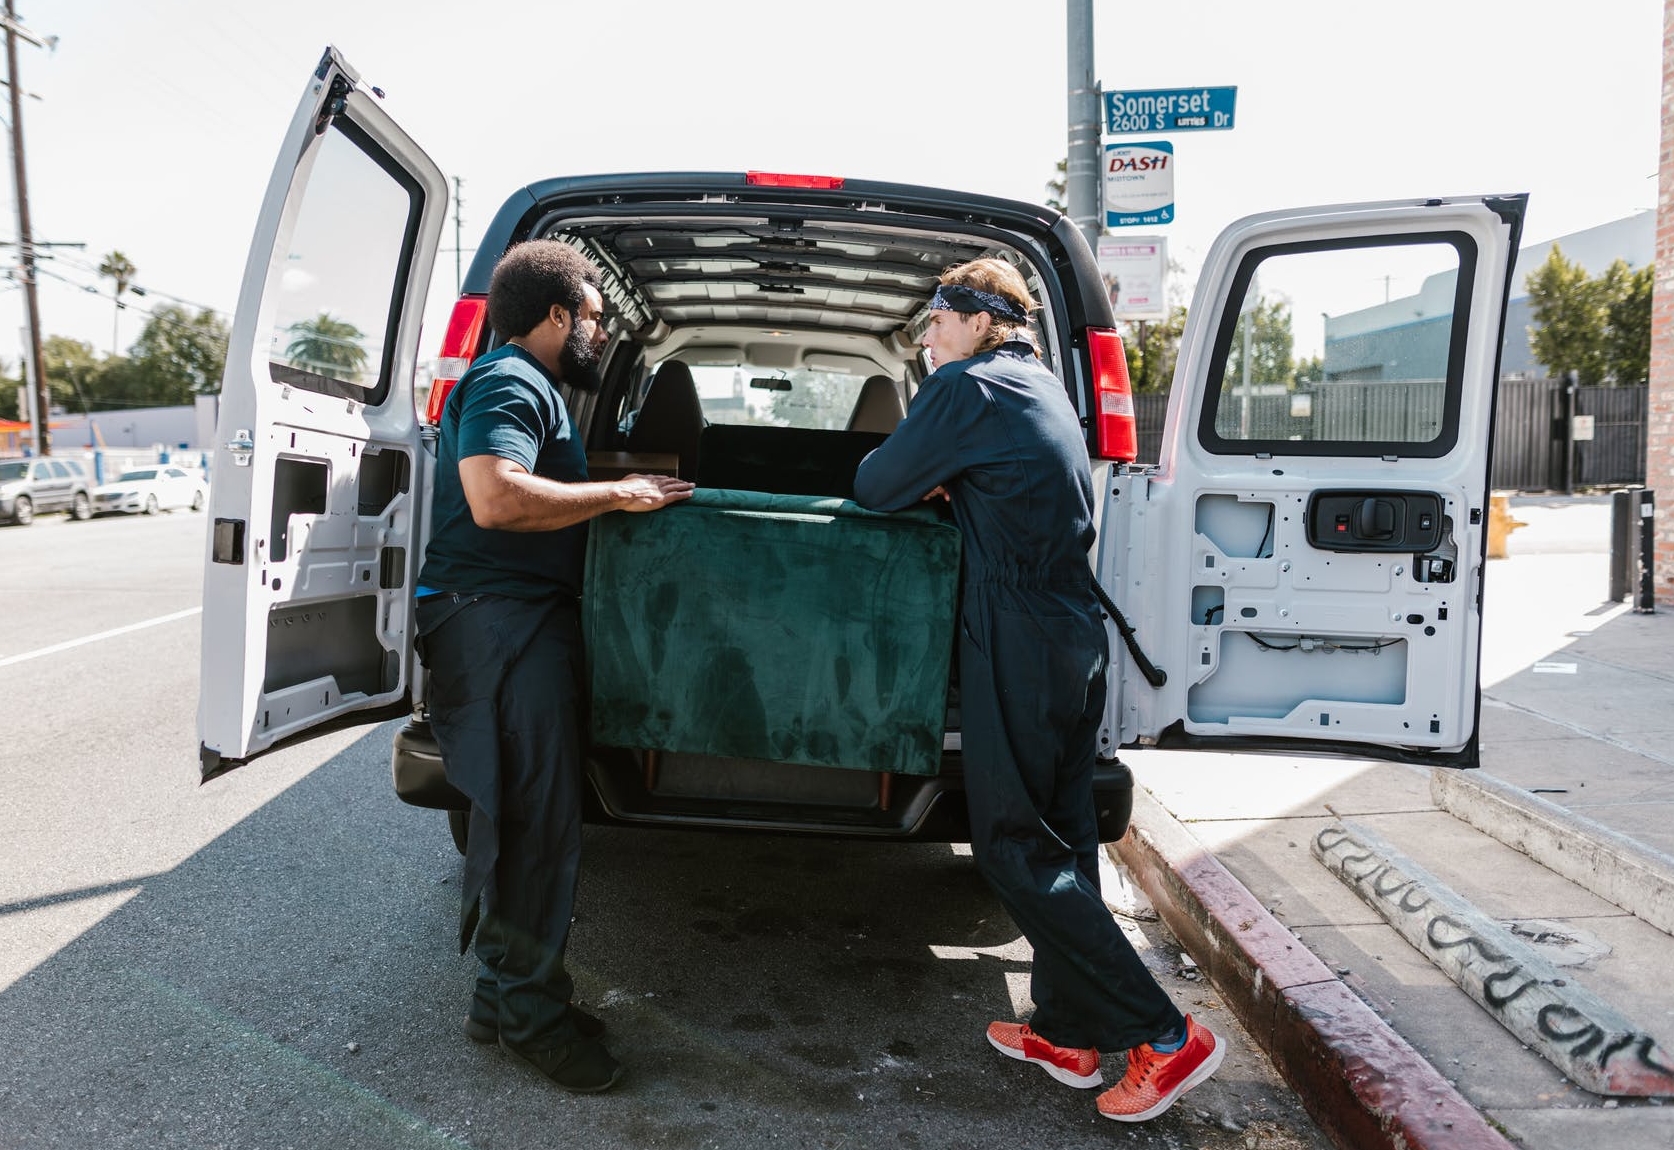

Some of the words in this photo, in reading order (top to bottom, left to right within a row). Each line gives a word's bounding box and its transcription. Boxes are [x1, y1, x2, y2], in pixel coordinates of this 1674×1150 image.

[1112, 90, 1210, 116] Somerset
[1112, 115, 1149, 132] 2600
[1155, 114, 1165, 129] S
[1214, 111, 1230, 127] Dr
[1109, 155, 1168, 172] DASH
